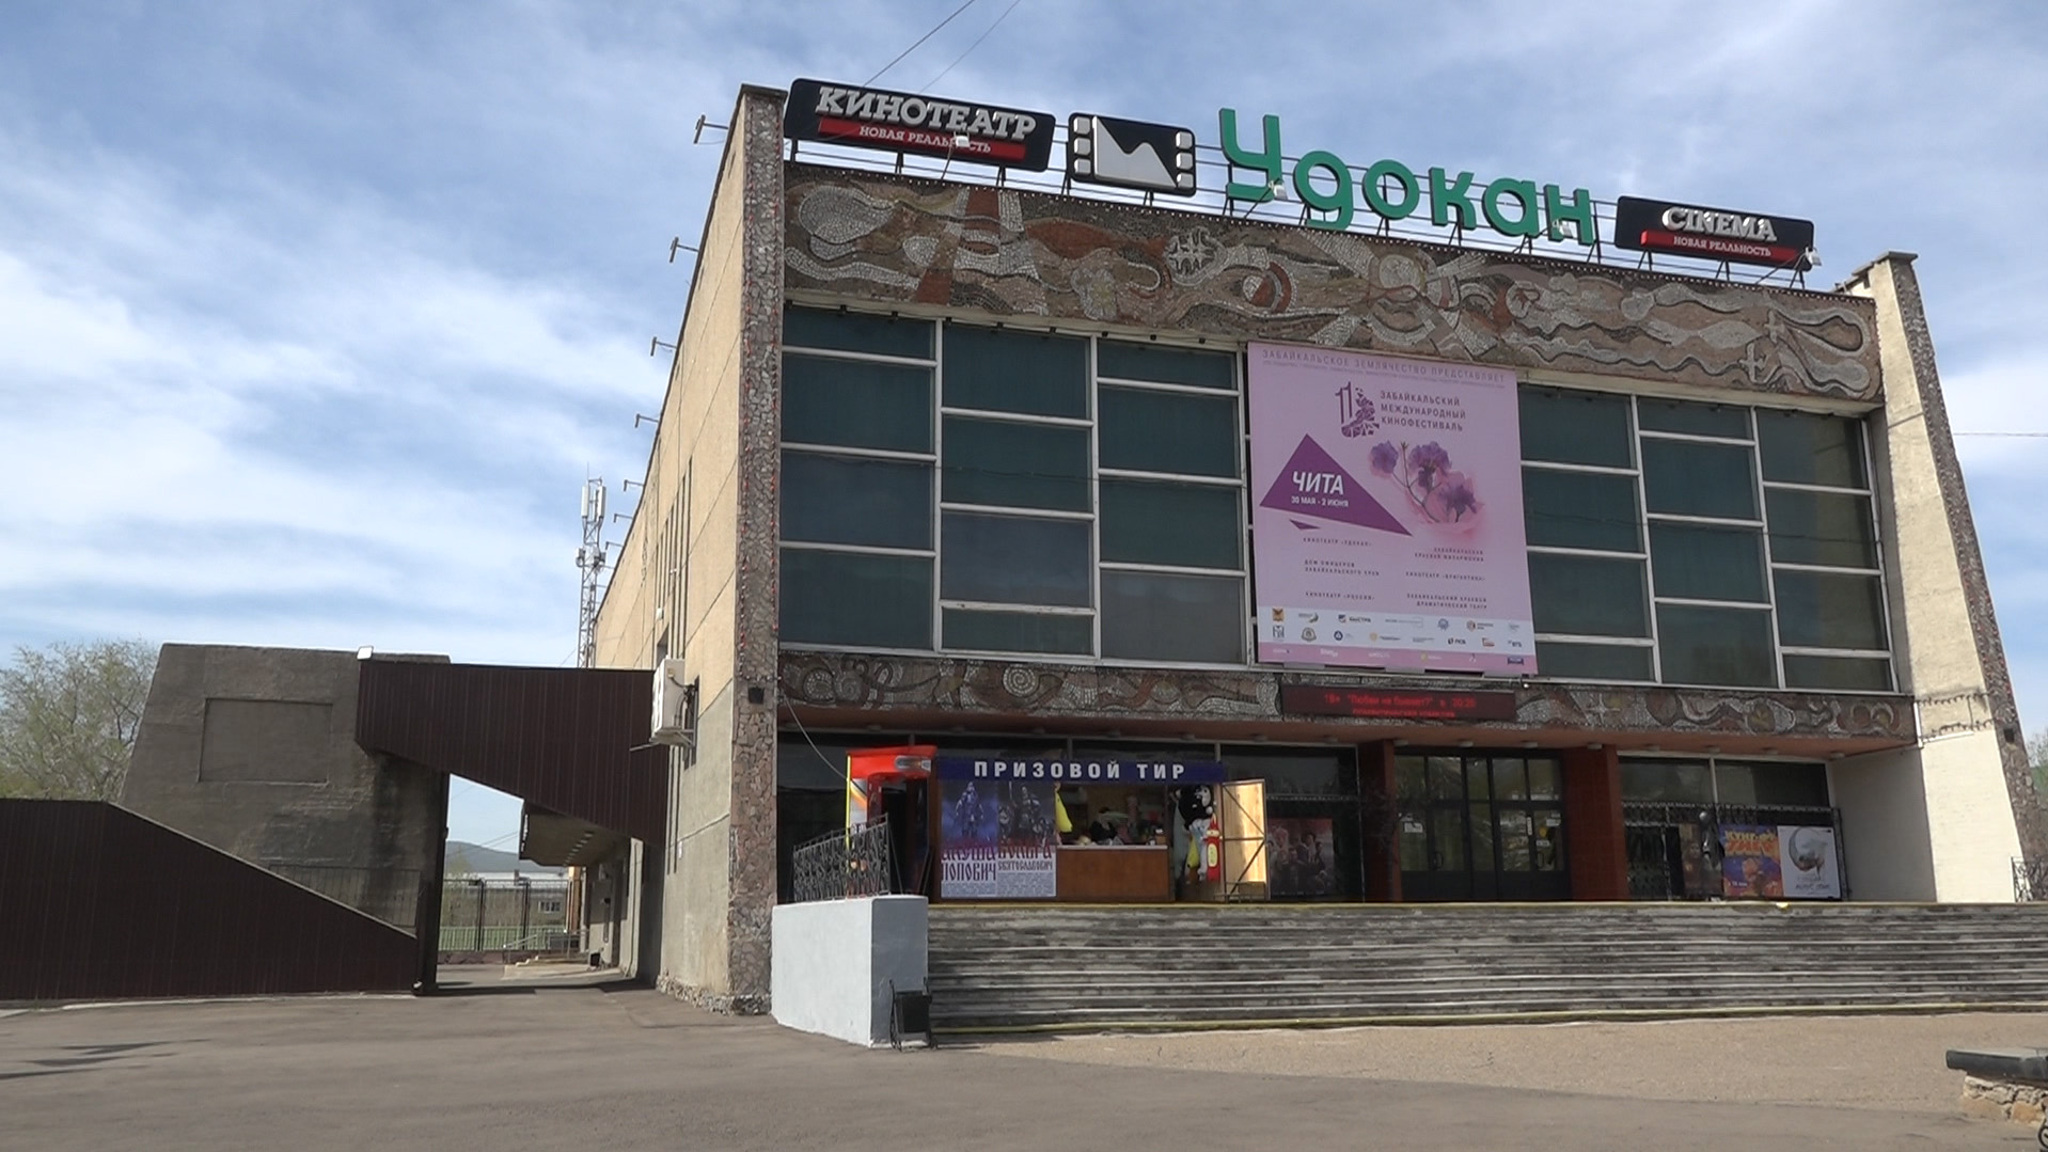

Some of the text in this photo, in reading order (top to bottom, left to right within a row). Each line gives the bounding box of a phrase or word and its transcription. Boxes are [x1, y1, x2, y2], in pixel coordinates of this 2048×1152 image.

[815, 86, 1036, 140] КИНОТЕАТР
[859, 125, 992, 153] НОВАЯ РЕАЛЬНСТЬ
[1219, 108, 1595, 246] Удокан
[1662, 206, 1777, 241] CINEMA
[1673, 236, 1771, 257] НОВАЯ РЕАЛЬНОСТЬ
[1262, 349, 1348, 366] ЗАБАЙКАЛЬСКОЕ
[1355, 358, 1427, 376] ЗЕМЛЯЧЕСТВО
[1431, 367, 1505, 383] ПРЕДСТАВЛЯЕТ
[1380, 390, 1460, 406] ЗАБАЙКАЛЬСКИЙ
[1380, 403, 1466, 419] МЕЖДУНАРОДНЫЙ
[1381, 416, 1463, 432] КИНОФЕСТИВАЛЬ
[1292, 471, 1344, 495] ЧИТА
[1301, 497, 1316, 505] МАЯ
[1321, 498, 1327, 506] 2
[1327, 499, 1349, 507] ИЮНЯ
[974, 760, 1185, 779] ПРИЗОВОЙ ТИР
